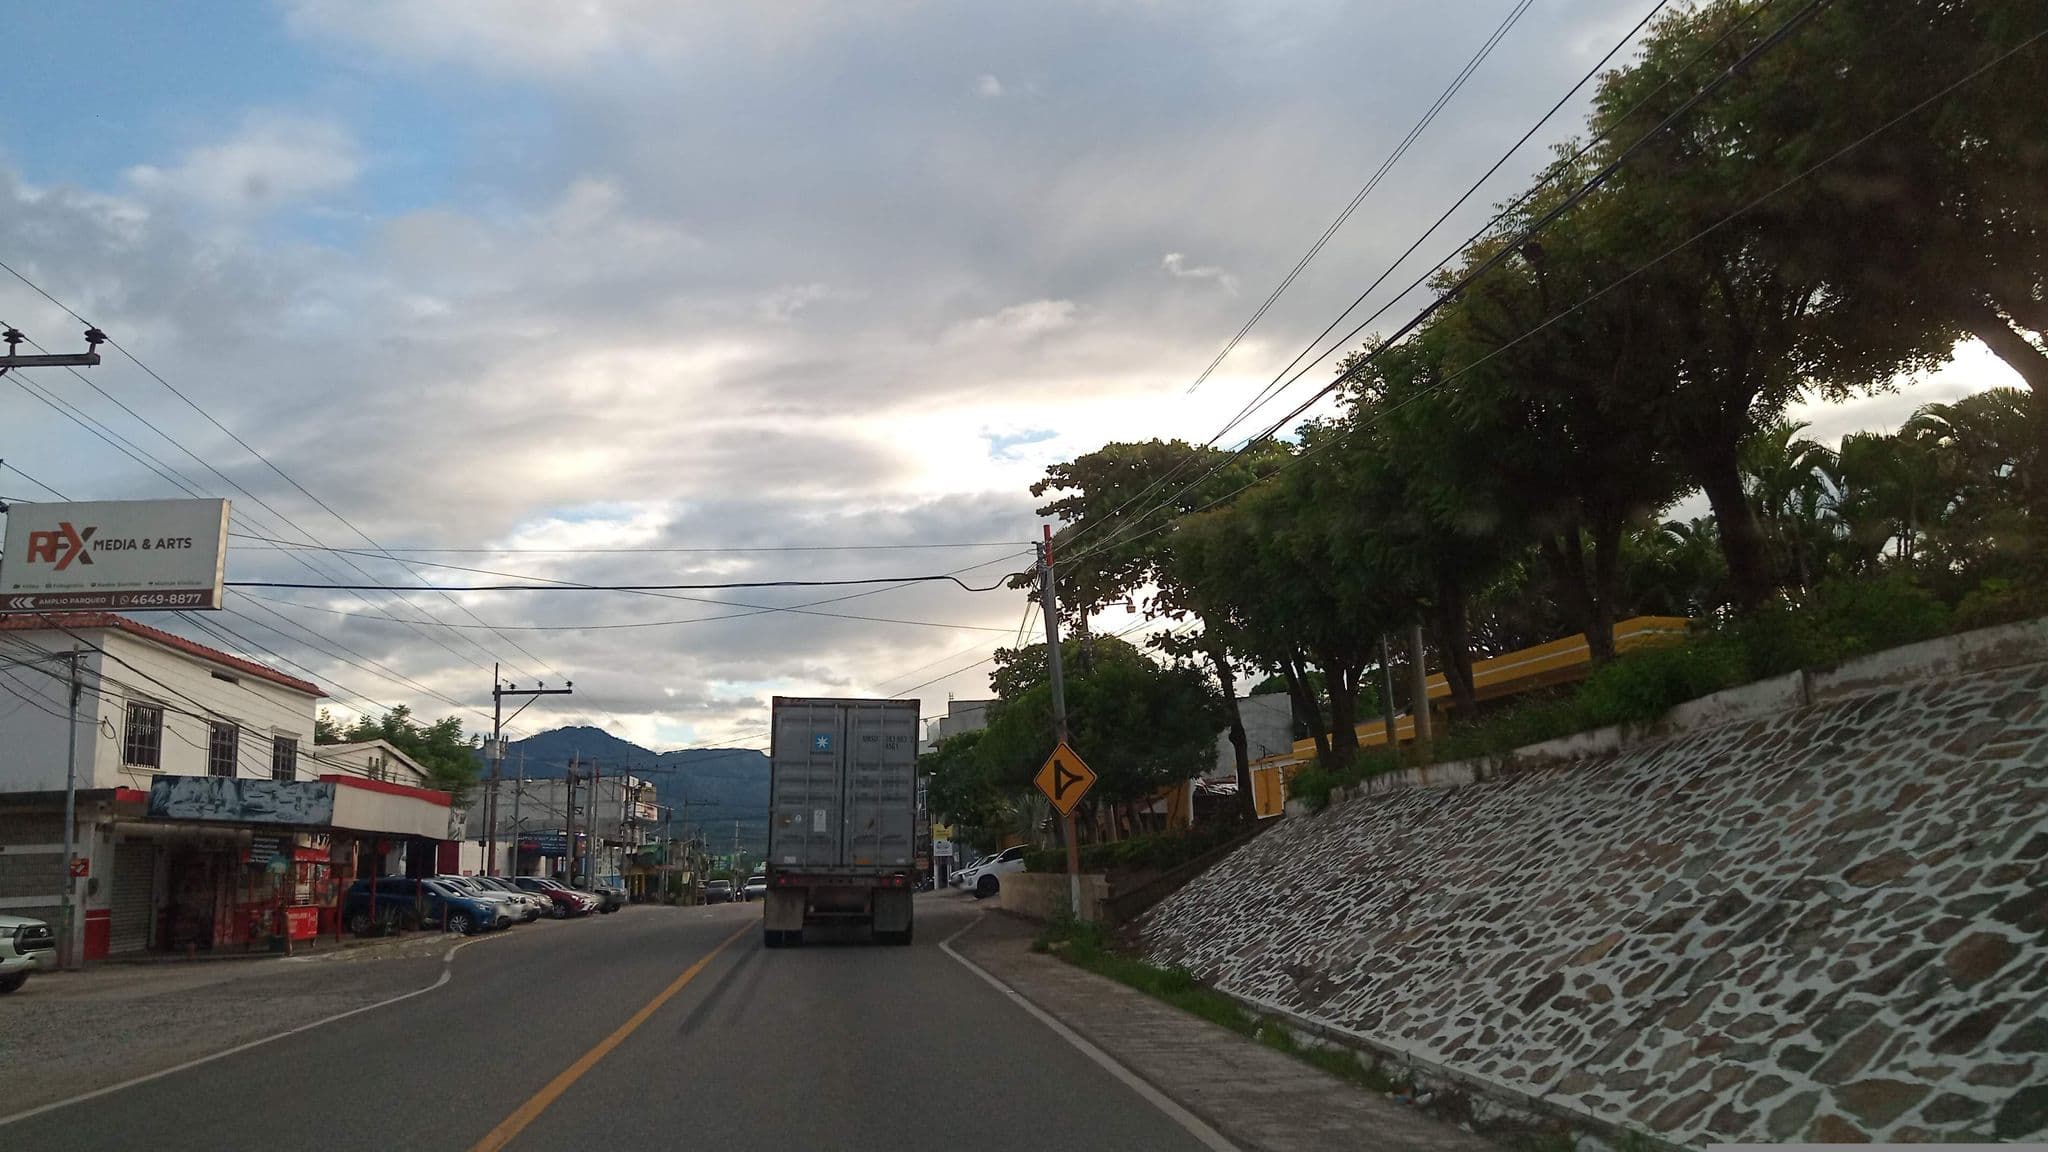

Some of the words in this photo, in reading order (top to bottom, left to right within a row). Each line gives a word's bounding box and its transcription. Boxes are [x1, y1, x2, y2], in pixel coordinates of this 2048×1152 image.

[93, 538, 137, 551] MEDIA
[142, 538, 151, 549] &
[156, 537, 192, 549] ARTS
[39, 597, 68, 605] AMPLIO
[70, 596, 106, 605] PARQUEO
[131, 594, 201, 605] 4649-8877
